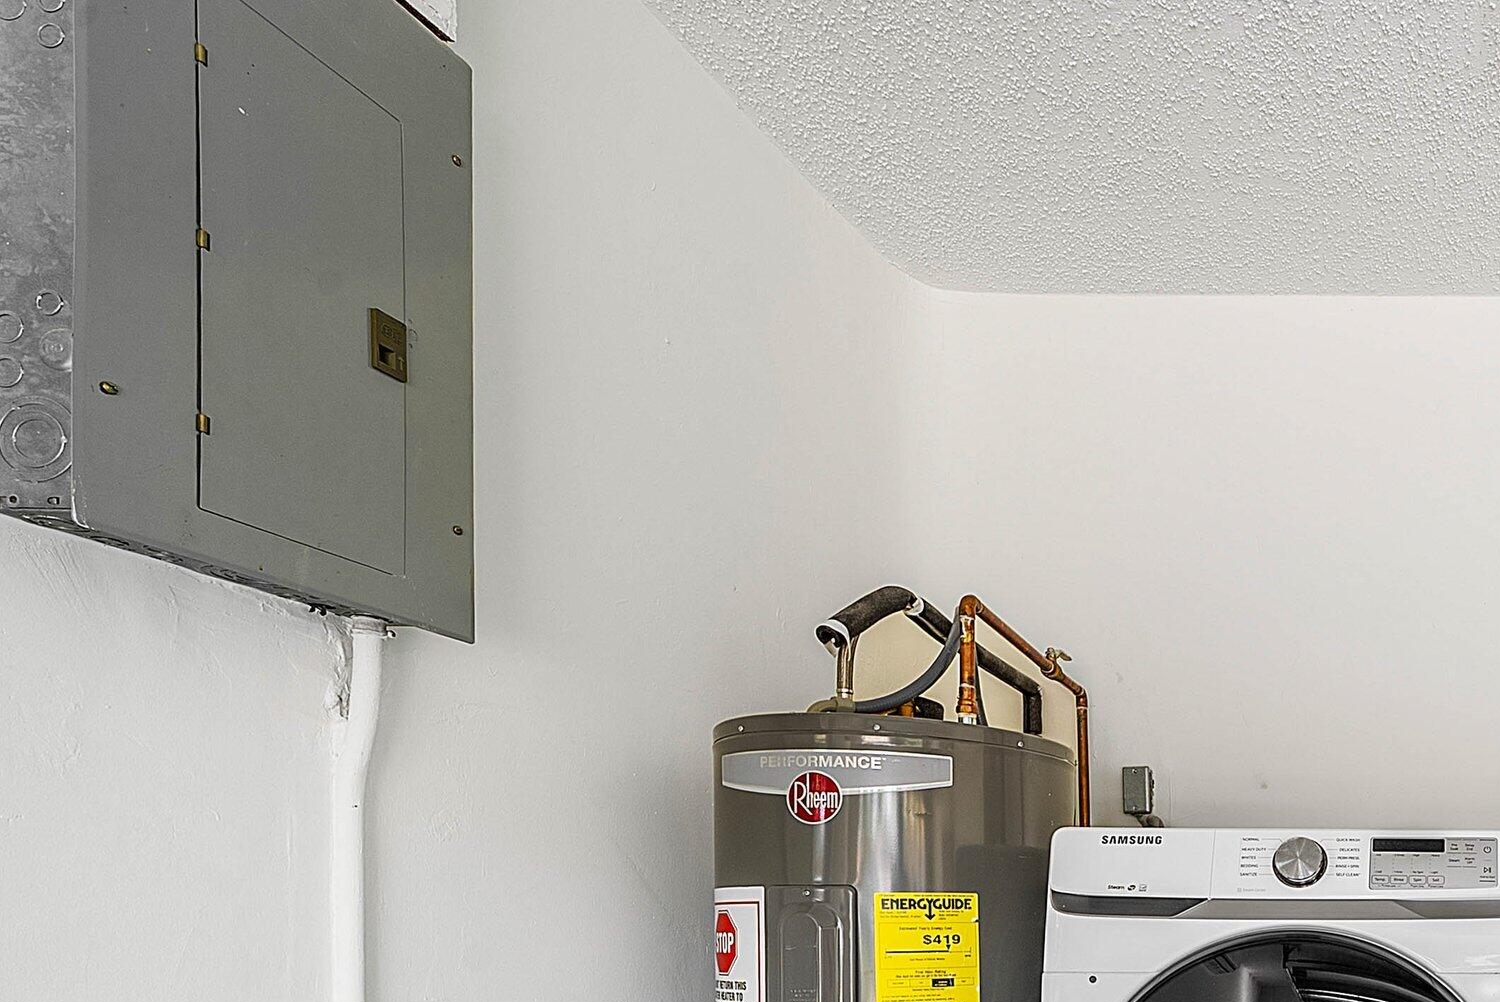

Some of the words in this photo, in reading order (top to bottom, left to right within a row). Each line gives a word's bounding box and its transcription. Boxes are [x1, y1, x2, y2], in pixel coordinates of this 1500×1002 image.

[760, 754, 882, 770] PERFORMANCE
[793, 773, 839, 816] Rheem
[1101, 835, 1163, 845] SAMSUNG
[881, 898, 972, 912] ENERGYGUIDE
